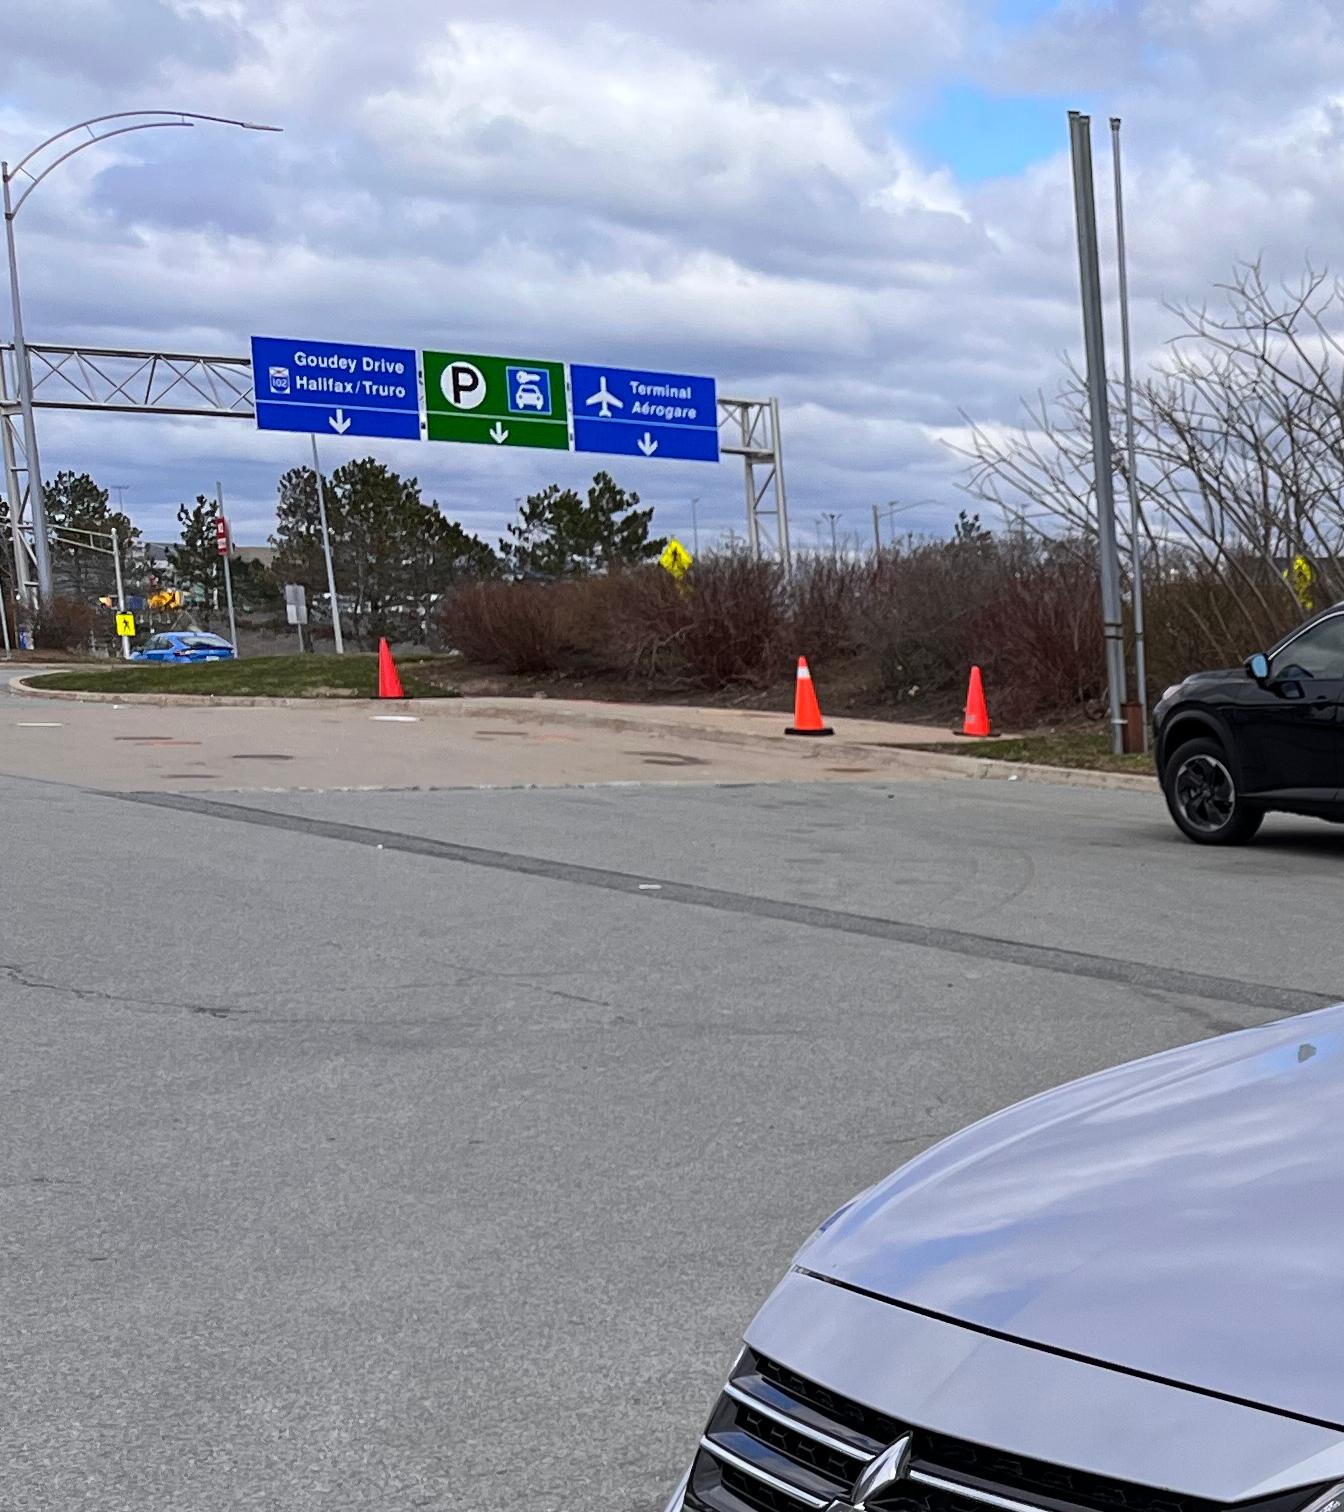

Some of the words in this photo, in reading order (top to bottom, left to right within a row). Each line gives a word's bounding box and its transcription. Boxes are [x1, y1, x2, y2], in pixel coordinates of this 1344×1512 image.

[294, 351, 357, 374] Goudey
[362, 357, 405, 375] Drive
[272, 378, 287, 388] 102
[295, 375, 406, 399] Halifax/Truro
[451, 366, 479, 404] P
[629, 380, 692, 400] Terminal
[631, 400, 697, 420] Aérogare
